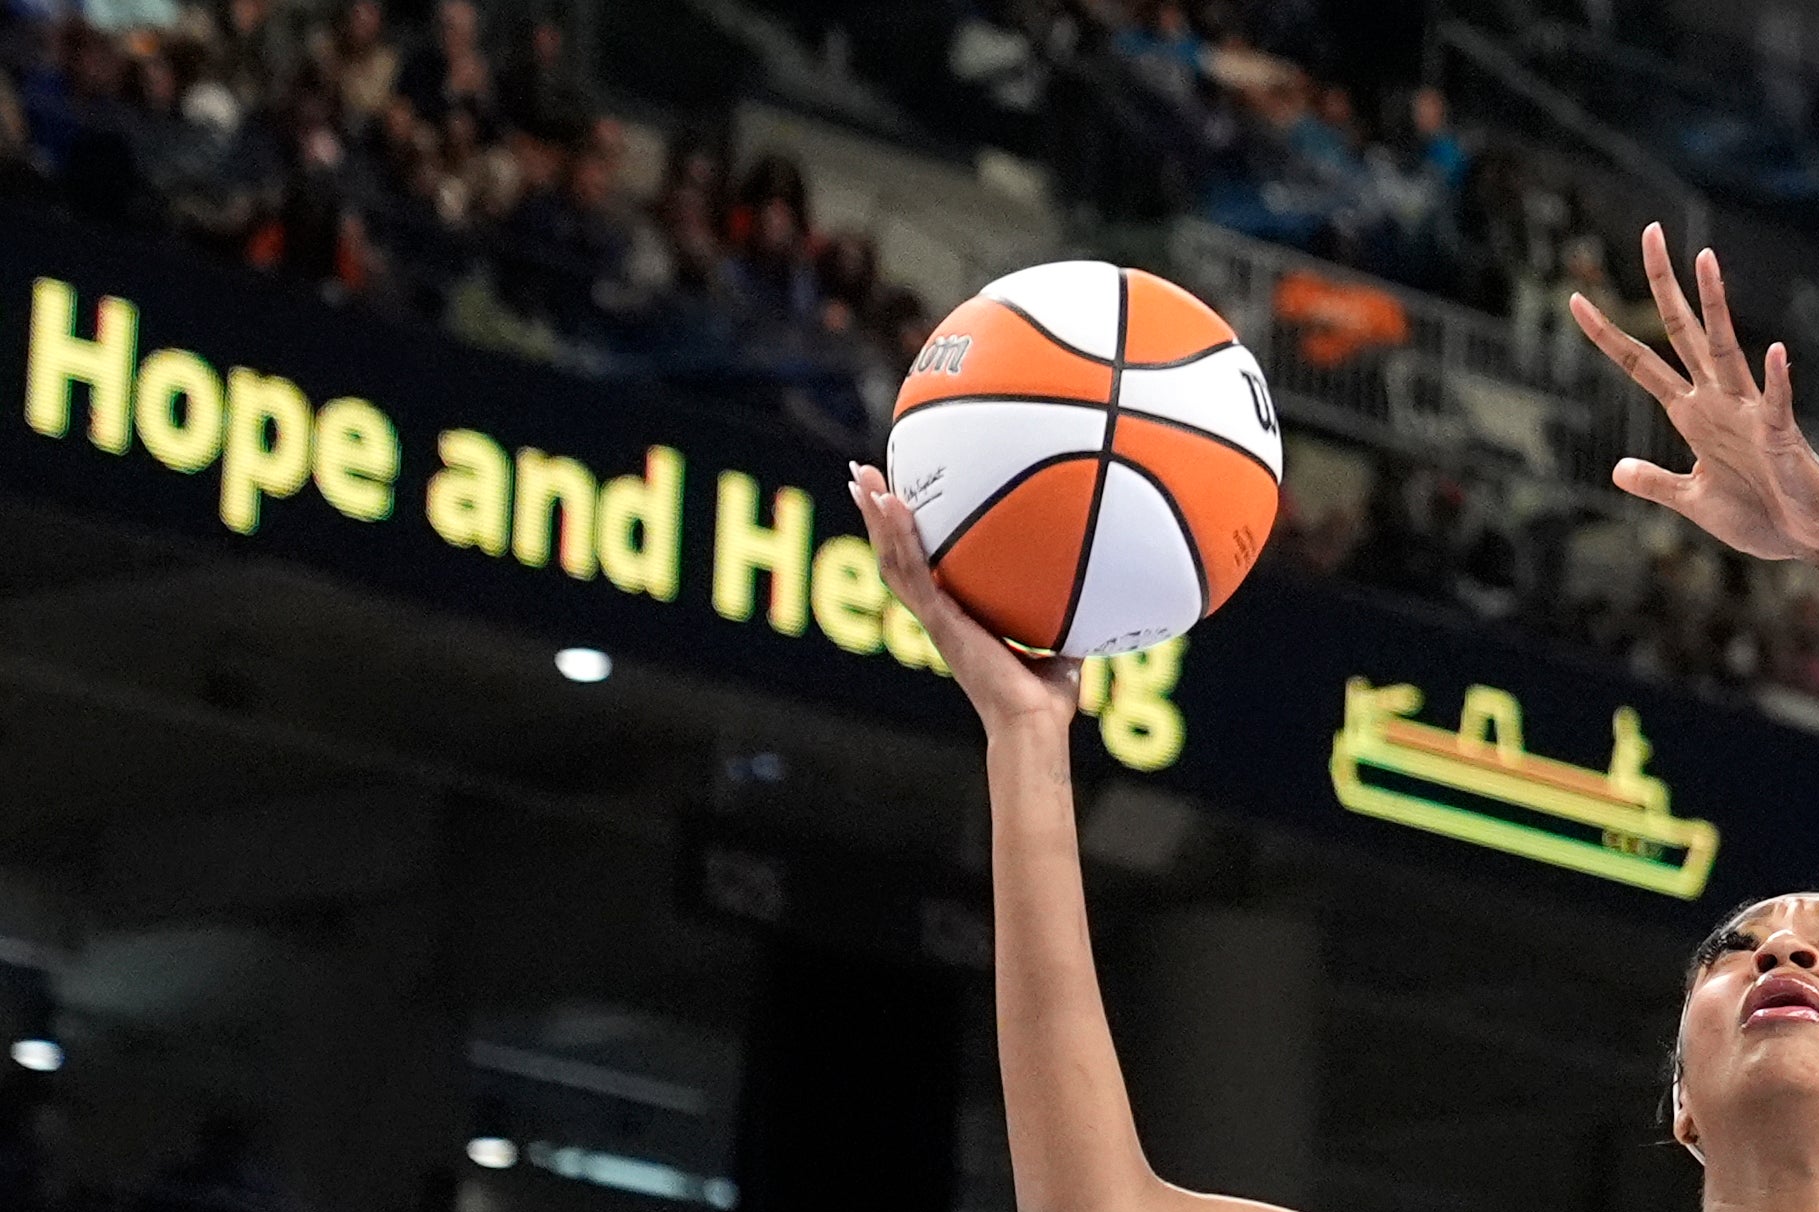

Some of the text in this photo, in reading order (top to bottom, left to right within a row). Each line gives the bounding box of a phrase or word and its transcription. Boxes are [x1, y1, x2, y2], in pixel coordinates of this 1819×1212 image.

[26, 276, 1189, 772] Hope and Heag
